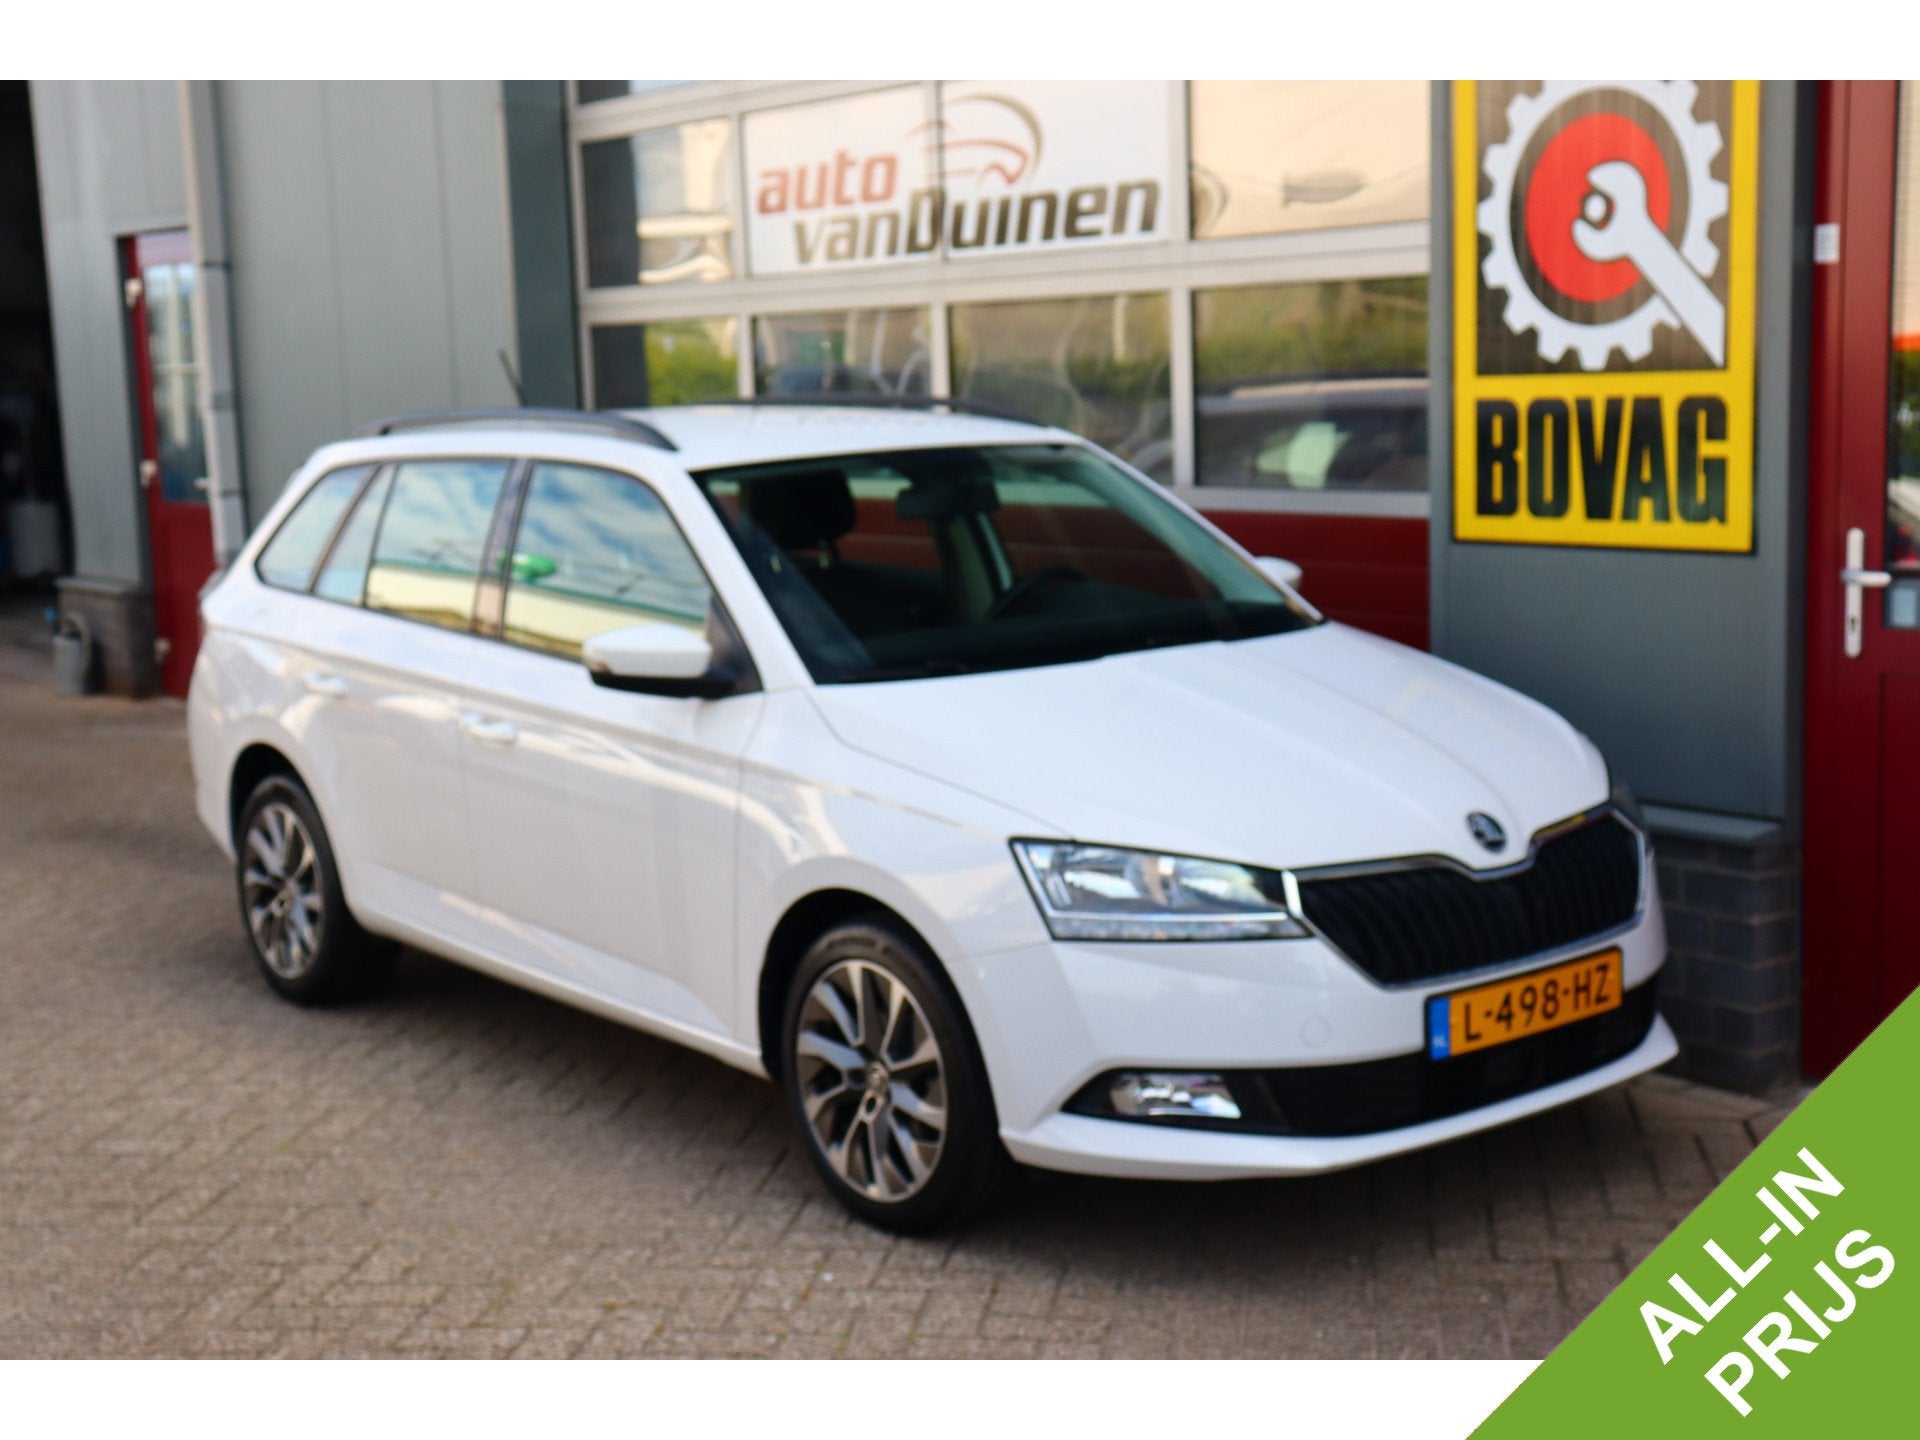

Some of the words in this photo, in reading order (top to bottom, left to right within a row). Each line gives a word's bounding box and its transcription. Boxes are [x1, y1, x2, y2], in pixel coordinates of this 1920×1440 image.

[757, 149, 898, 214] auto
[1476, 394, 1728, 525] BOVAG
[1464, 964, 1610, 1042] L-498-HZ
